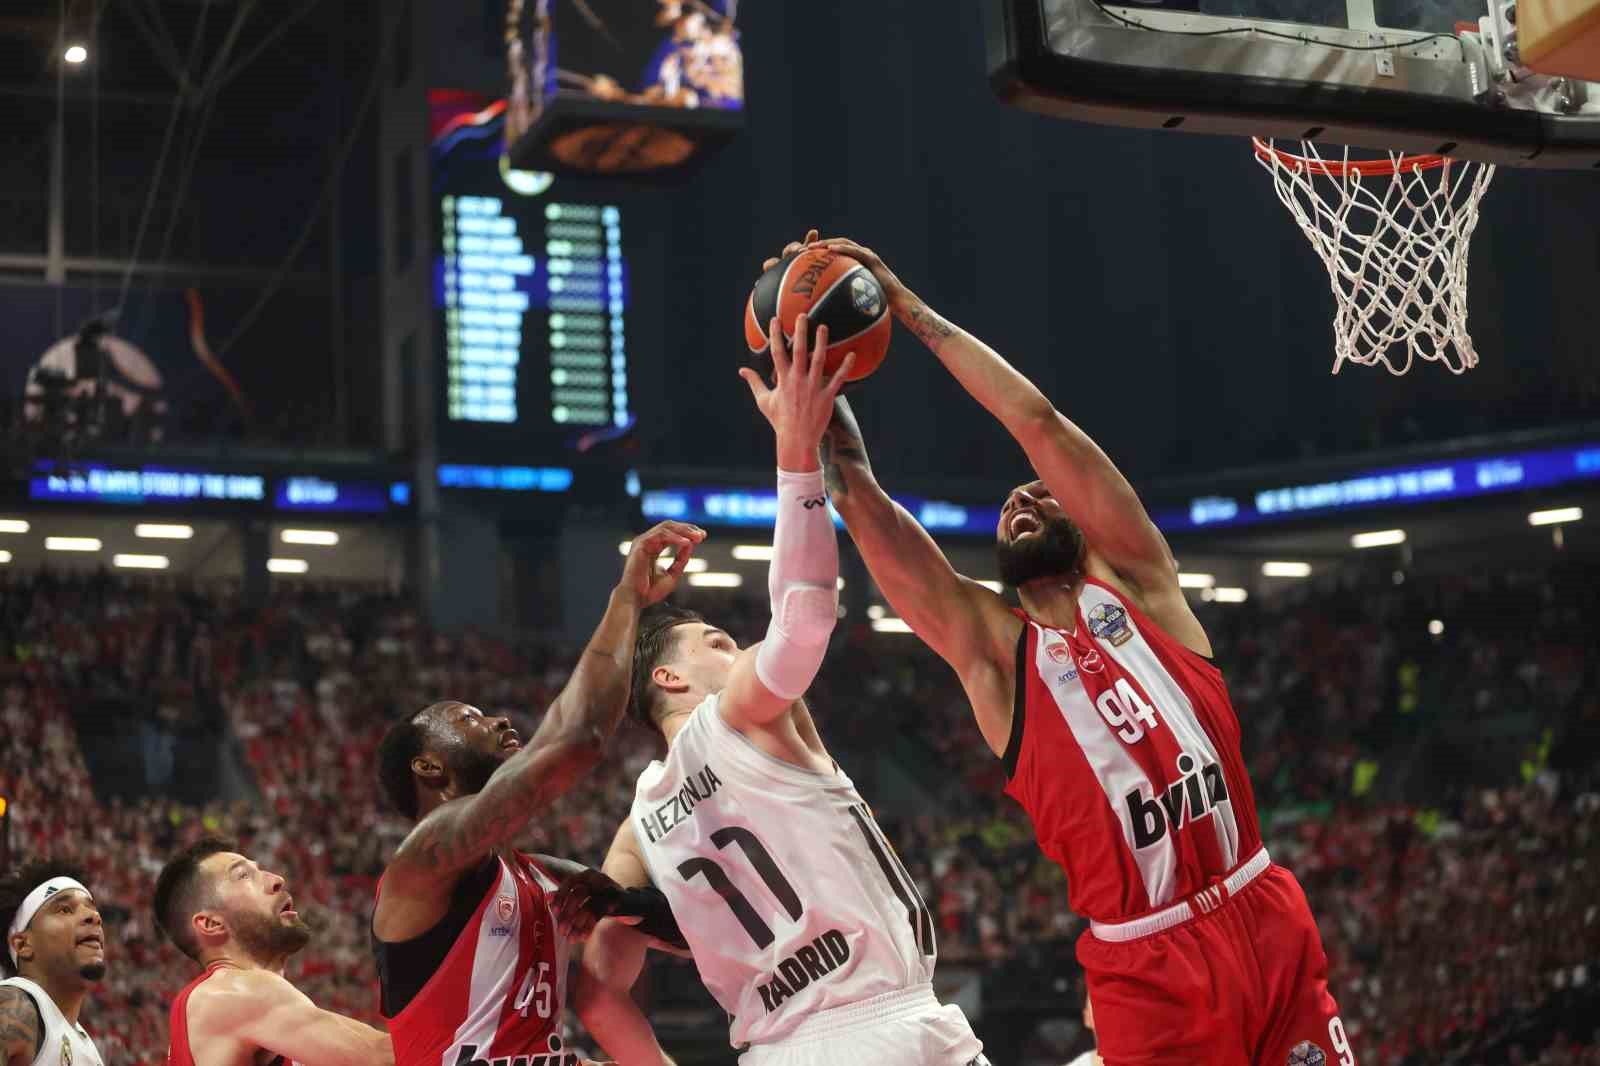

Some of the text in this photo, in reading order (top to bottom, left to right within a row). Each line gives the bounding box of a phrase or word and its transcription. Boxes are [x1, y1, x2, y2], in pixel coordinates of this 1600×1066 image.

[791, 254, 835, 301] SPAL
[1096, 677, 1158, 745] 94
[641, 763, 722, 843] HEZONJA
[676, 825, 803, 950] 11
[514, 961, 551, 1019] 45
[1328, 1016, 1355, 1066] 9
